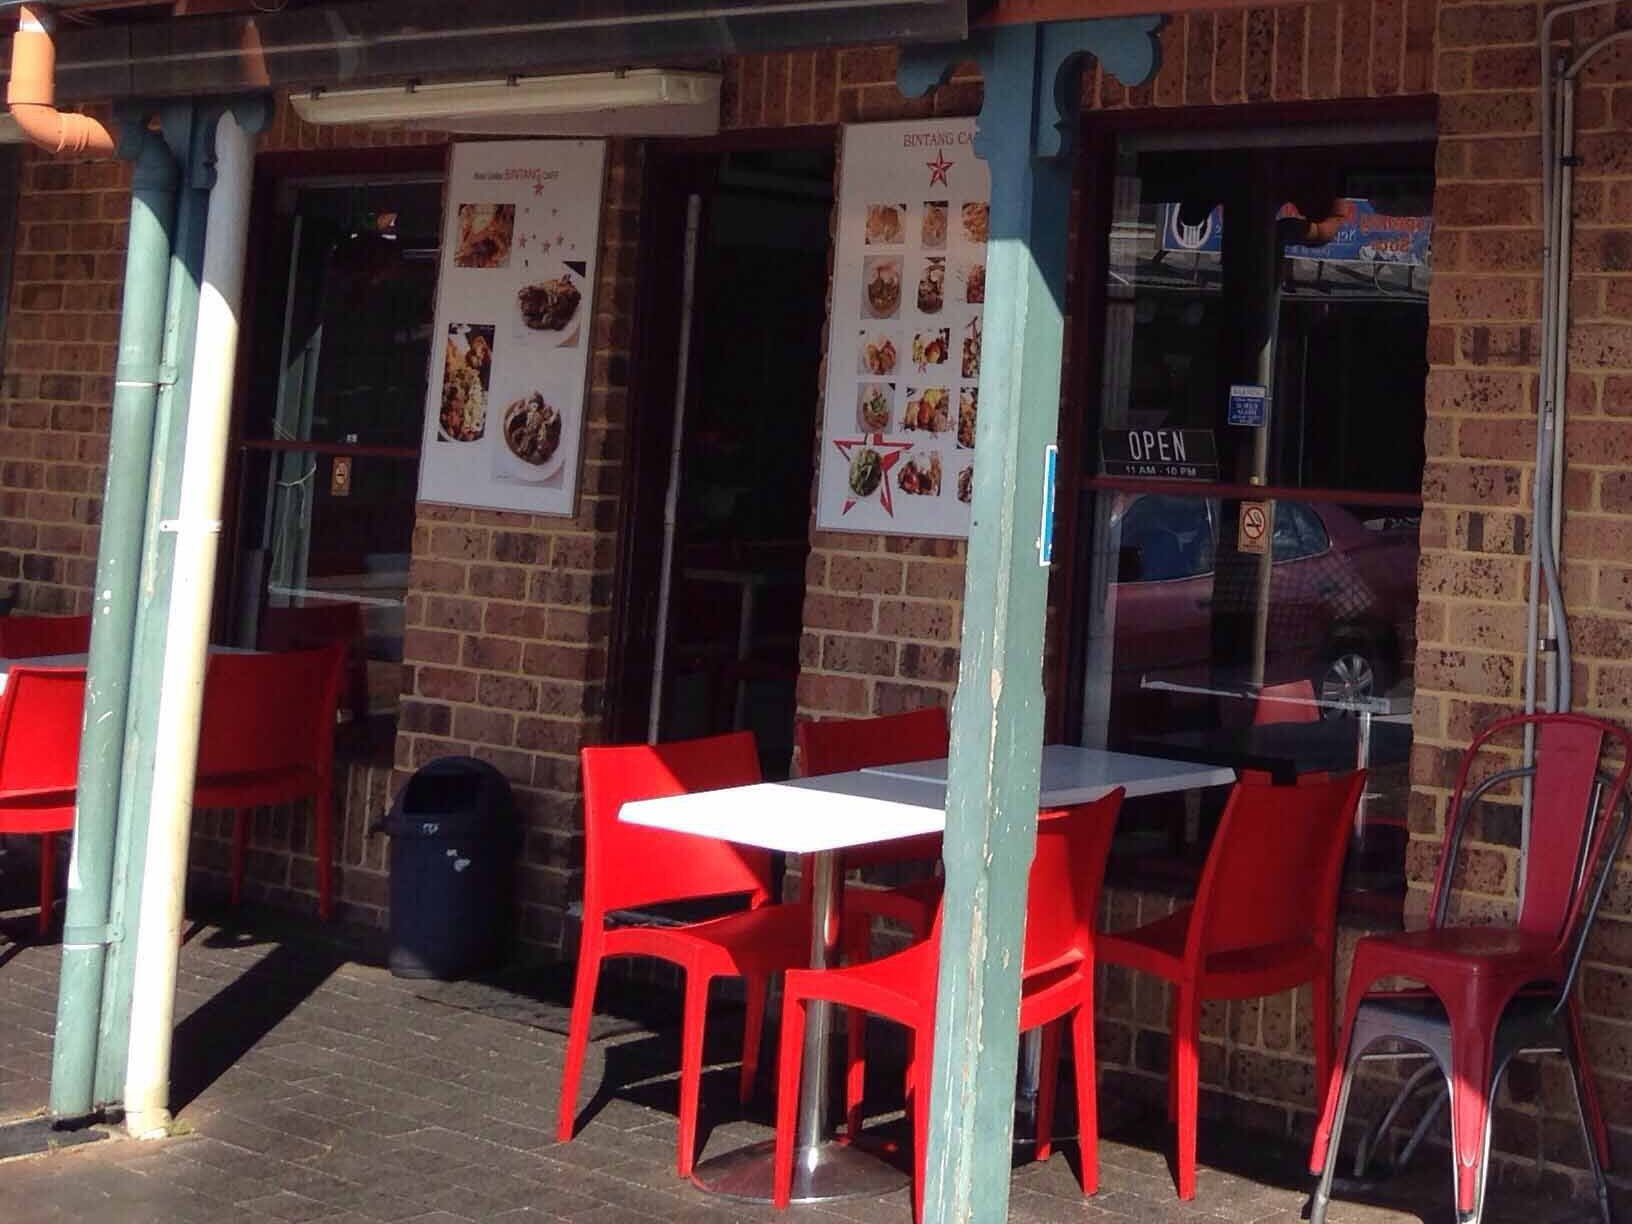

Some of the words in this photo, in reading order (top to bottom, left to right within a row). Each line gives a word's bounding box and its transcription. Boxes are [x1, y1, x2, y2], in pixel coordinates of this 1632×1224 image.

[1128, 431, 1187, 462] OPEN
[1138, 466, 1157, 475] AM
[1179, 467, 1197, 477] PM
